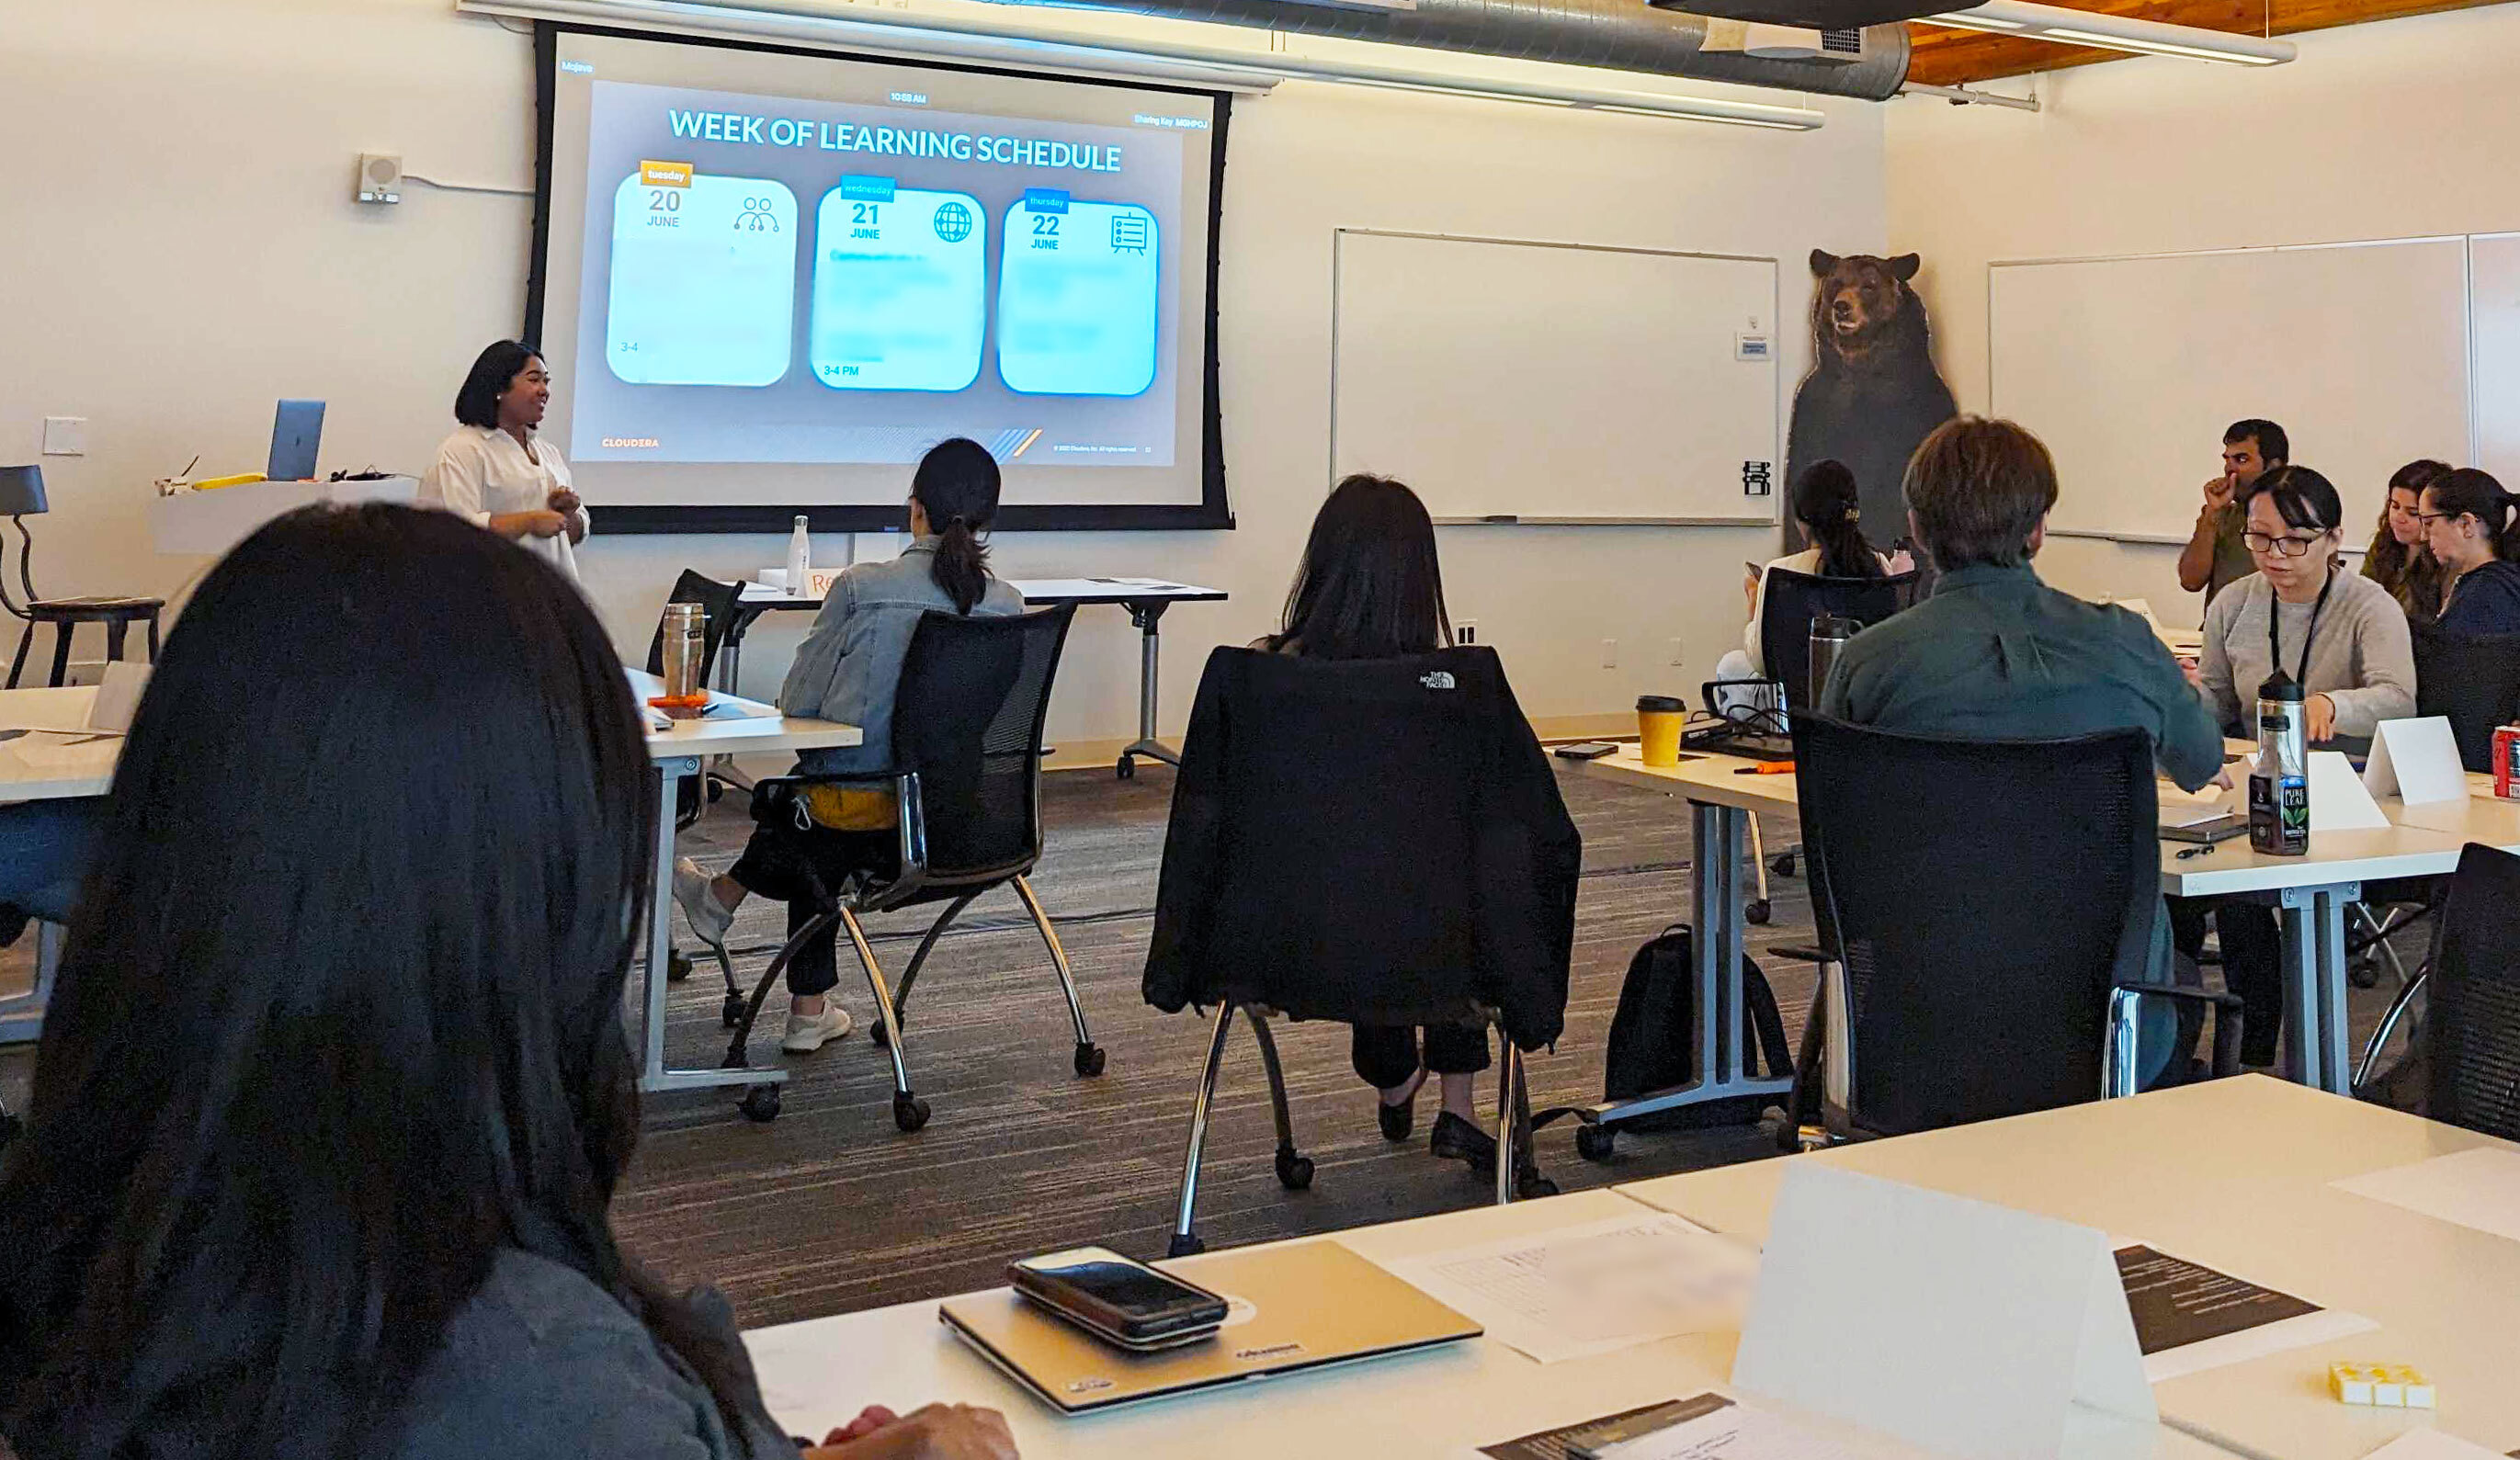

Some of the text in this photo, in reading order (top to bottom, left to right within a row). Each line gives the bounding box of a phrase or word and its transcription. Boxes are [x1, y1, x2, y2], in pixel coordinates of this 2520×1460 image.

[913, 94, 926, 104] AM
[669, 109, 1121, 172] WEEK OF LEARNING SCHEDULE
[648, 170, 686, 183] tuesday
[845, 185, 891, 197] wednesday
[649, 189, 680, 212] 20
[1030, 197, 1064, 209] thursday
[852, 203, 879, 225] 21
[646, 215, 680, 228] JUNE
[1033, 215, 1060, 236] 22
[850, 228, 880, 240] JUNE
[1031, 238, 1059, 250] JUNE
[620, 342, 638, 352] 3-4
[823, 365, 859, 376] 3-4 PM
[602, 438, 659, 447] CLOUDERA
